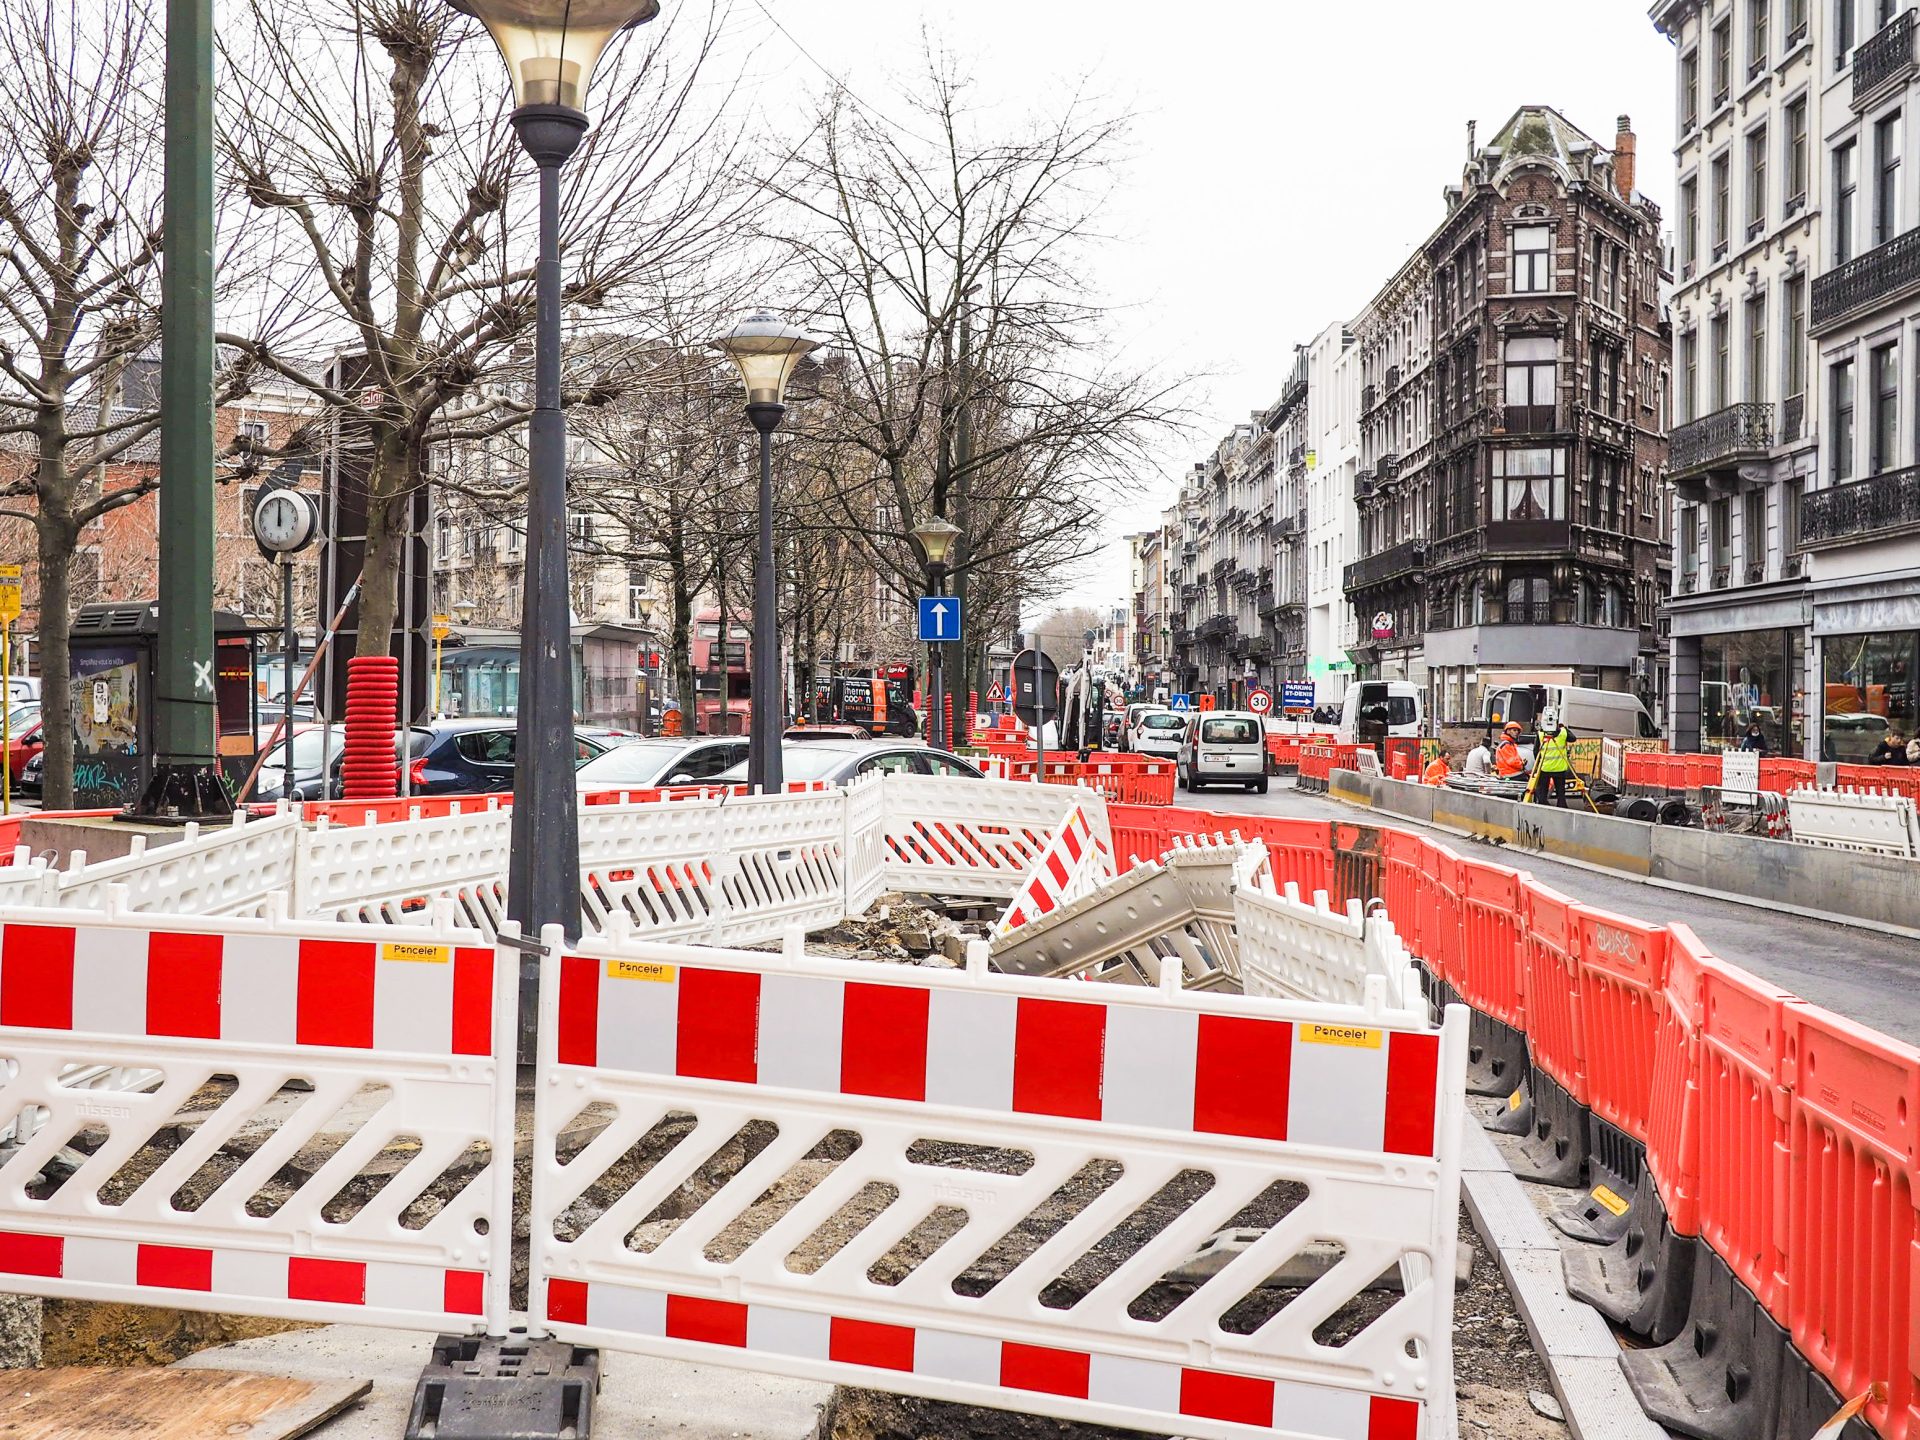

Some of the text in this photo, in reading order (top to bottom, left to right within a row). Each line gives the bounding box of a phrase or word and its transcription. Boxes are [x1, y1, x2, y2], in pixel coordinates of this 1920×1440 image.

[1253, 697, 1267, 706] 30
[394, 945, 437, 955] Poncelet
[619, 962, 663, 975] Poncelet
[1314, 1025, 1367, 1039] Poncelet
